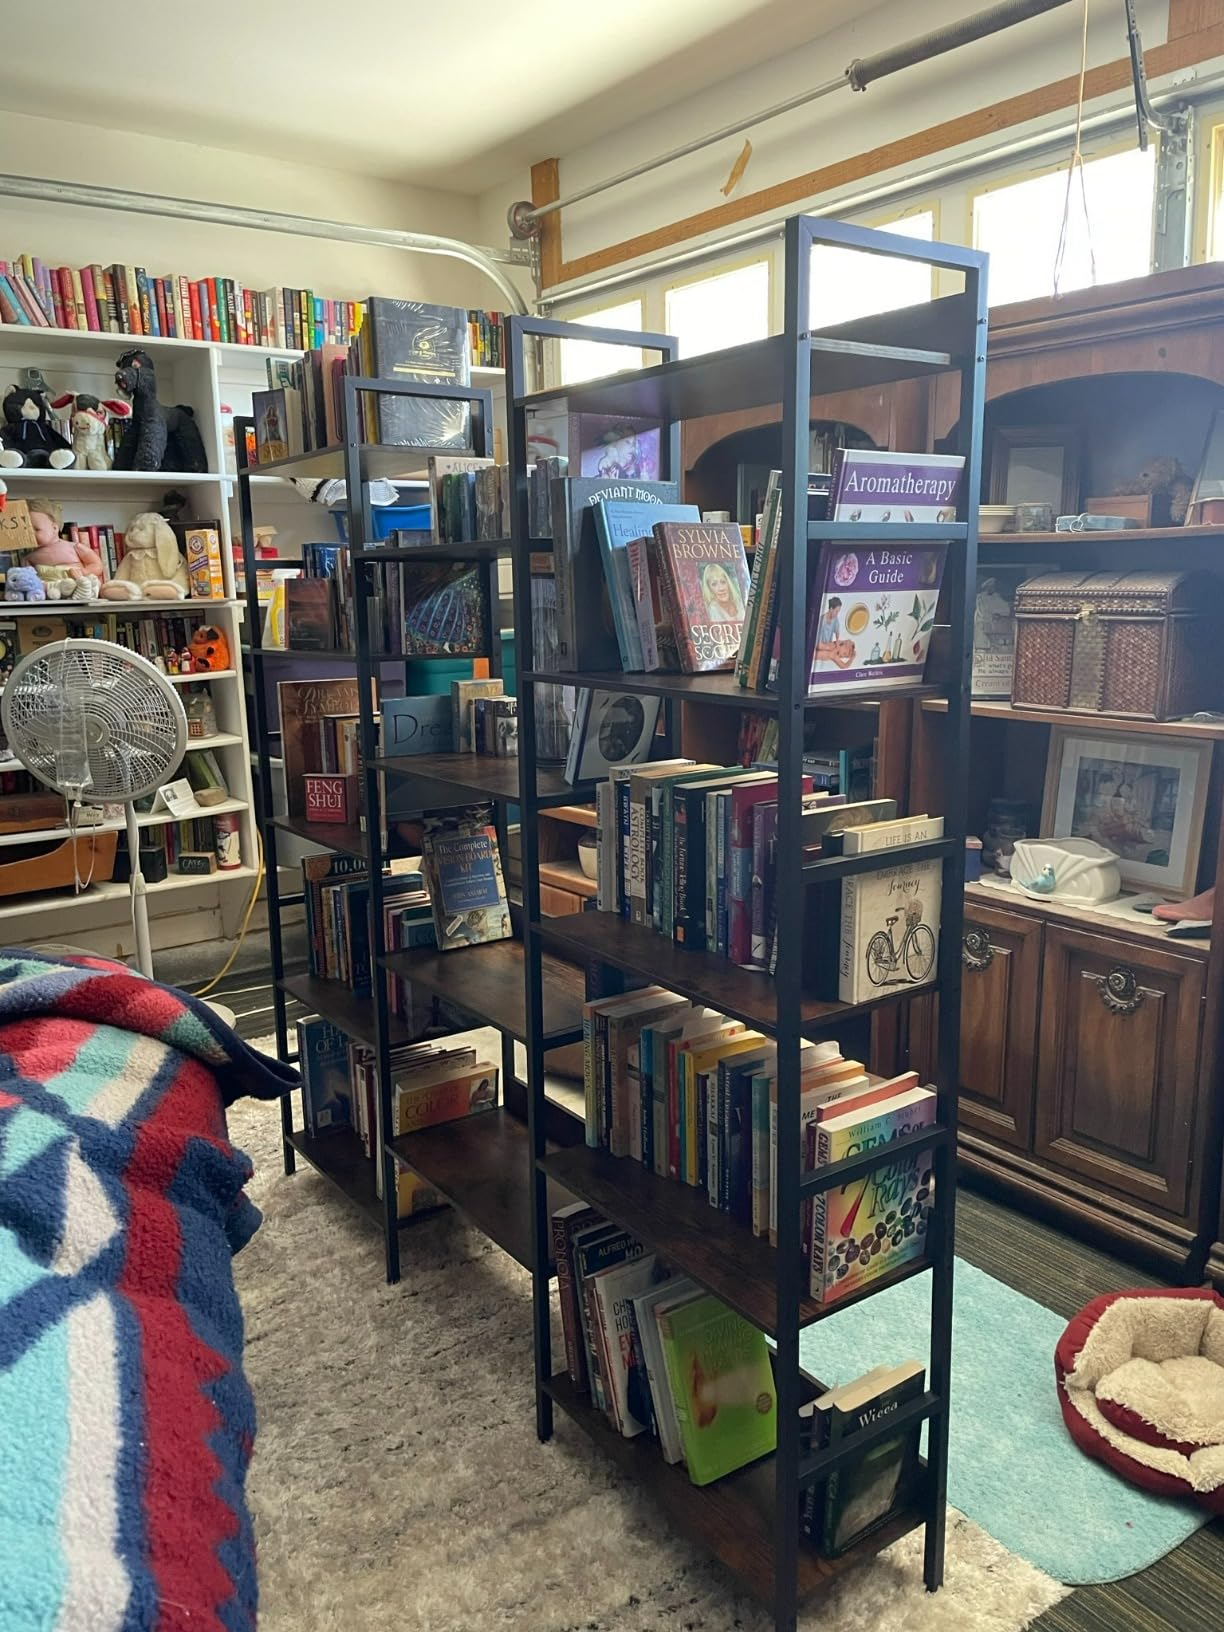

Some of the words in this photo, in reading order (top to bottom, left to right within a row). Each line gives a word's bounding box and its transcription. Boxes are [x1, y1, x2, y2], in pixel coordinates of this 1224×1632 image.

[844, 470, 957, 502] Aromatherapy
[588, 486, 634, 506] DEVIANT
[612, 523, 652, 538] Healin
[677, 528, 730, 545] SYLVIA
[672, 543, 742, 560] BROWNE
[866, 551, 876, 566] A
[880, 551, 913, 566] Basic
[868, 569, 904, 584] Guide
[691, 623, 744, 646] SECRE
[306, 780, 342, 794] FENG
[308, 793, 341, 808] SHUI
[631, 807, 641, 883] ASTROLOGY
[885, 835, 902, 847] LIFE
[904, 833, 912, 843] IS
[914, 830, 928, 841] AN
[888, 880, 921, 897] Journey
[848, 1122, 881, 1138] William
[857, 1401, 898, 1429] Wicca
